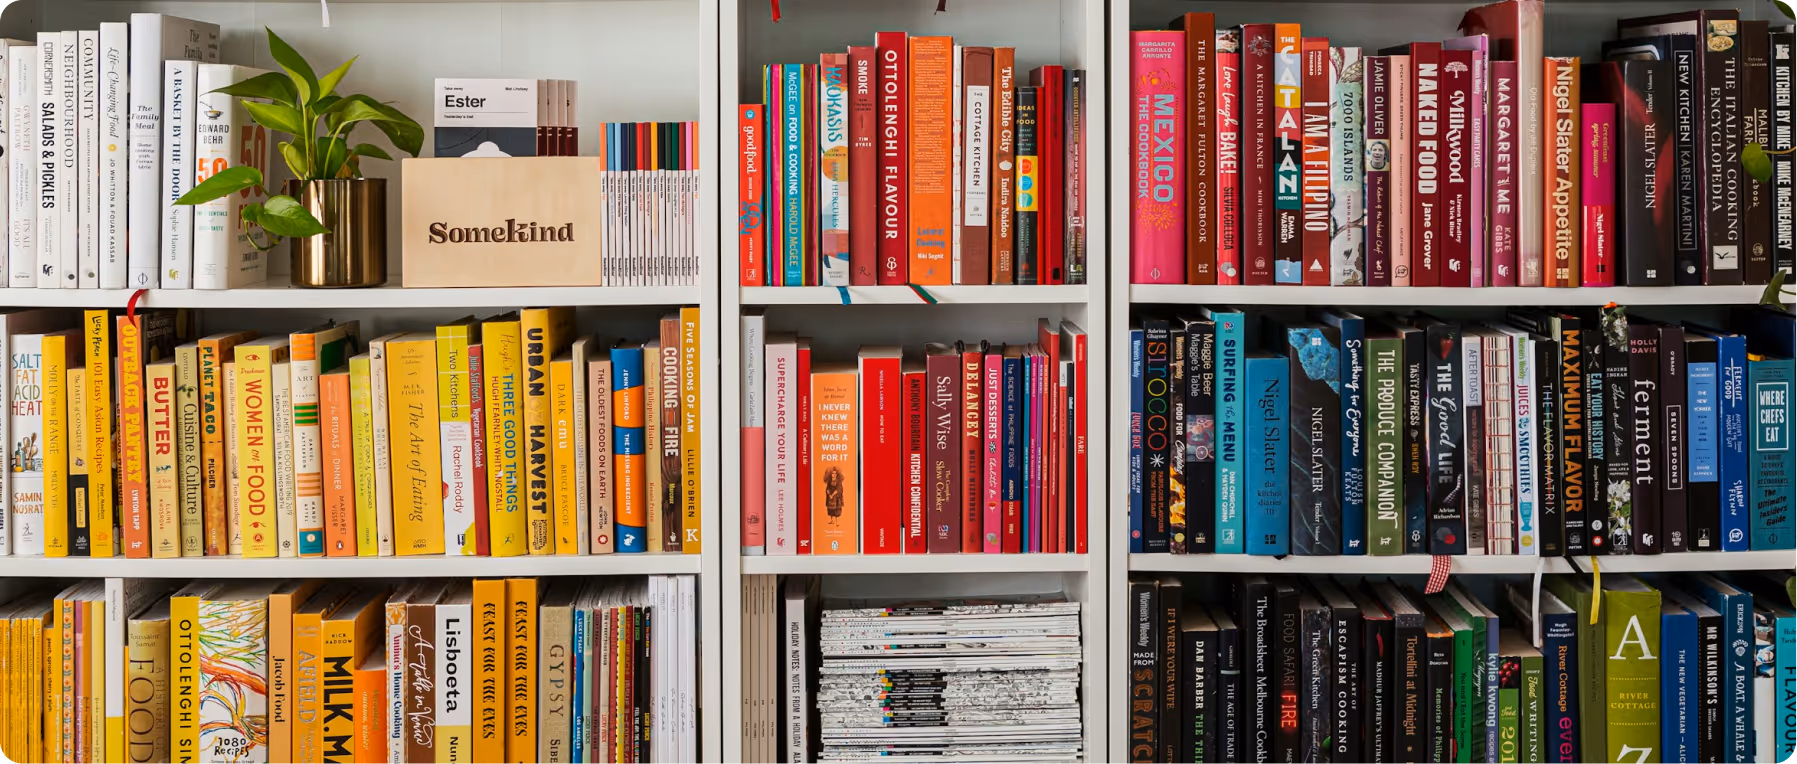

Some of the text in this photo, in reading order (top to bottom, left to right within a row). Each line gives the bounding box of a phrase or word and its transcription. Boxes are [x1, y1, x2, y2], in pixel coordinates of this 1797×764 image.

[64, 44, 74, 168] NEIGHBOURHOOD
[84, 38, 93, 121] COMMUNITY
[173, 79, 182, 122] BASKET
[445, 95, 486, 108] Ester
[789, 72, 797, 102] McGEE
[789, 105, 796, 114] on
[858, 60, 867, 94] SMOKE
[1000, 67, 1011, 152] The Edible City
[1374, 60, 1384, 134] JAMIE OLIVER
[42, 103, 54, 146] SALADS
[108, 114, 118, 138] Food
[172, 141, 181, 164] THE
[173, 125, 181, 139] BY
[204, 136, 223, 144] BEHR
[789, 117, 797, 141] FOOD
[885, 50, 898, 238] OTTOLENGHI FLAVOUR
[973, 102, 981, 186] COTTAGE KITCHEN
[1154, 94, 1173, 202] MEXICO
[1305, 115, 1327, 136] AM
[1305, 145, 1327, 153] A
[1343, 92, 1353, 181] 7000 ISLANDS
[1418, 64, 1437, 194] NAKED FOOD
[1446, 90, 1465, 183] Milkwood
[1711, 87, 1721, 211] ENCYCLOPEDIA
[1725, 58, 1737, 240] THE ITALIAN COOKING
[42, 163, 55, 208] PICKLES
[171, 168, 180, 201] DOOR
[789, 154, 797, 194] COOKING
[1305, 161, 1328, 231] FILIPINO
[1553, 66, 1574, 260] Nigel Slater Appetite
[169, 209, 178, 231] Sophie
[429, 219, 574, 244] Somekind
[1001, 178, 1009, 237] Indira Naidoo
[1198, 182, 1206, 242] COOKBOOK
[12, 354, 42, 369] SALT
[14, 385, 40, 400] ACID
[16, 369, 38, 384] FAT
[92, 380, 102, 402] Easy
[203, 347, 215, 434] PLANET TACO
[777, 358, 785, 429] SUPERCHARGE
[1203, 334, 1212, 395] Maggie Beer
[12, 401, 43, 415] HEAT
[94, 406, 103, 433] Asian
[154, 377, 170, 454] BUTTER
[528, 329, 546, 513] URBAN HARVEST
[932, 376, 952, 449] Sally Wise
[967, 363, 978, 437] DELANCEY
[989, 368, 997, 439] JUST DESSERTS
[1431, 363, 1457, 483] THE Good LIFE
[1563, 330, 1583, 512] MAXIMUM FLAVOR
[1635, 379, 1655, 485] ferment
[1760, 391, 1785, 406] WHERE
[1760, 409, 1784, 423] CHEFS
[94, 437, 104, 473] Recipes
[184, 404, 200, 514] Cuisine & Culture
[246, 379, 265, 515] WOMEN on FOOD
[503, 373, 518, 512] THREE GOOD THINGS
[777, 433, 785, 461] YOUR
[1311, 407, 1323, 492] NIGEL SLATER
[1378, 350, 1397, 528] THE PRODUCE COMPANION
[1766, 427, 1779, 442] EAT
[452, 446, 464, 513] Rachel Roddy
[911, 454, 920, 537] KITCHEN CONFIDENTIAL
[180, 620, 191, 729] OTTOLENGHI
[273, 656, 285, 722] Jacob Food
[299, 650, 316, 723] AFIELD
[446, 618, 460, 713] Lisboeta
[483, 603, 495, 739] FEAST FOR THE EYES
[550, 645, 564, 717] GYPSY
[1195, 641, 1204, 709] DAN BARBER
[1281, 614, 1296, 728] FOOD SAFARI FIRE
[1338, 620, 1346, 753] ESCAPISM COOKING
[1403, 636, 1417, 735] Tortellini at Midnight
[1487, 653, 1498, 726] kylie kwong
[1558, 645, 1567, 712] River Cottage
[1706, 627, 1717, 704] MR WILKINSON'S
[1785, 667, 1796, 753] FLAVOUR
